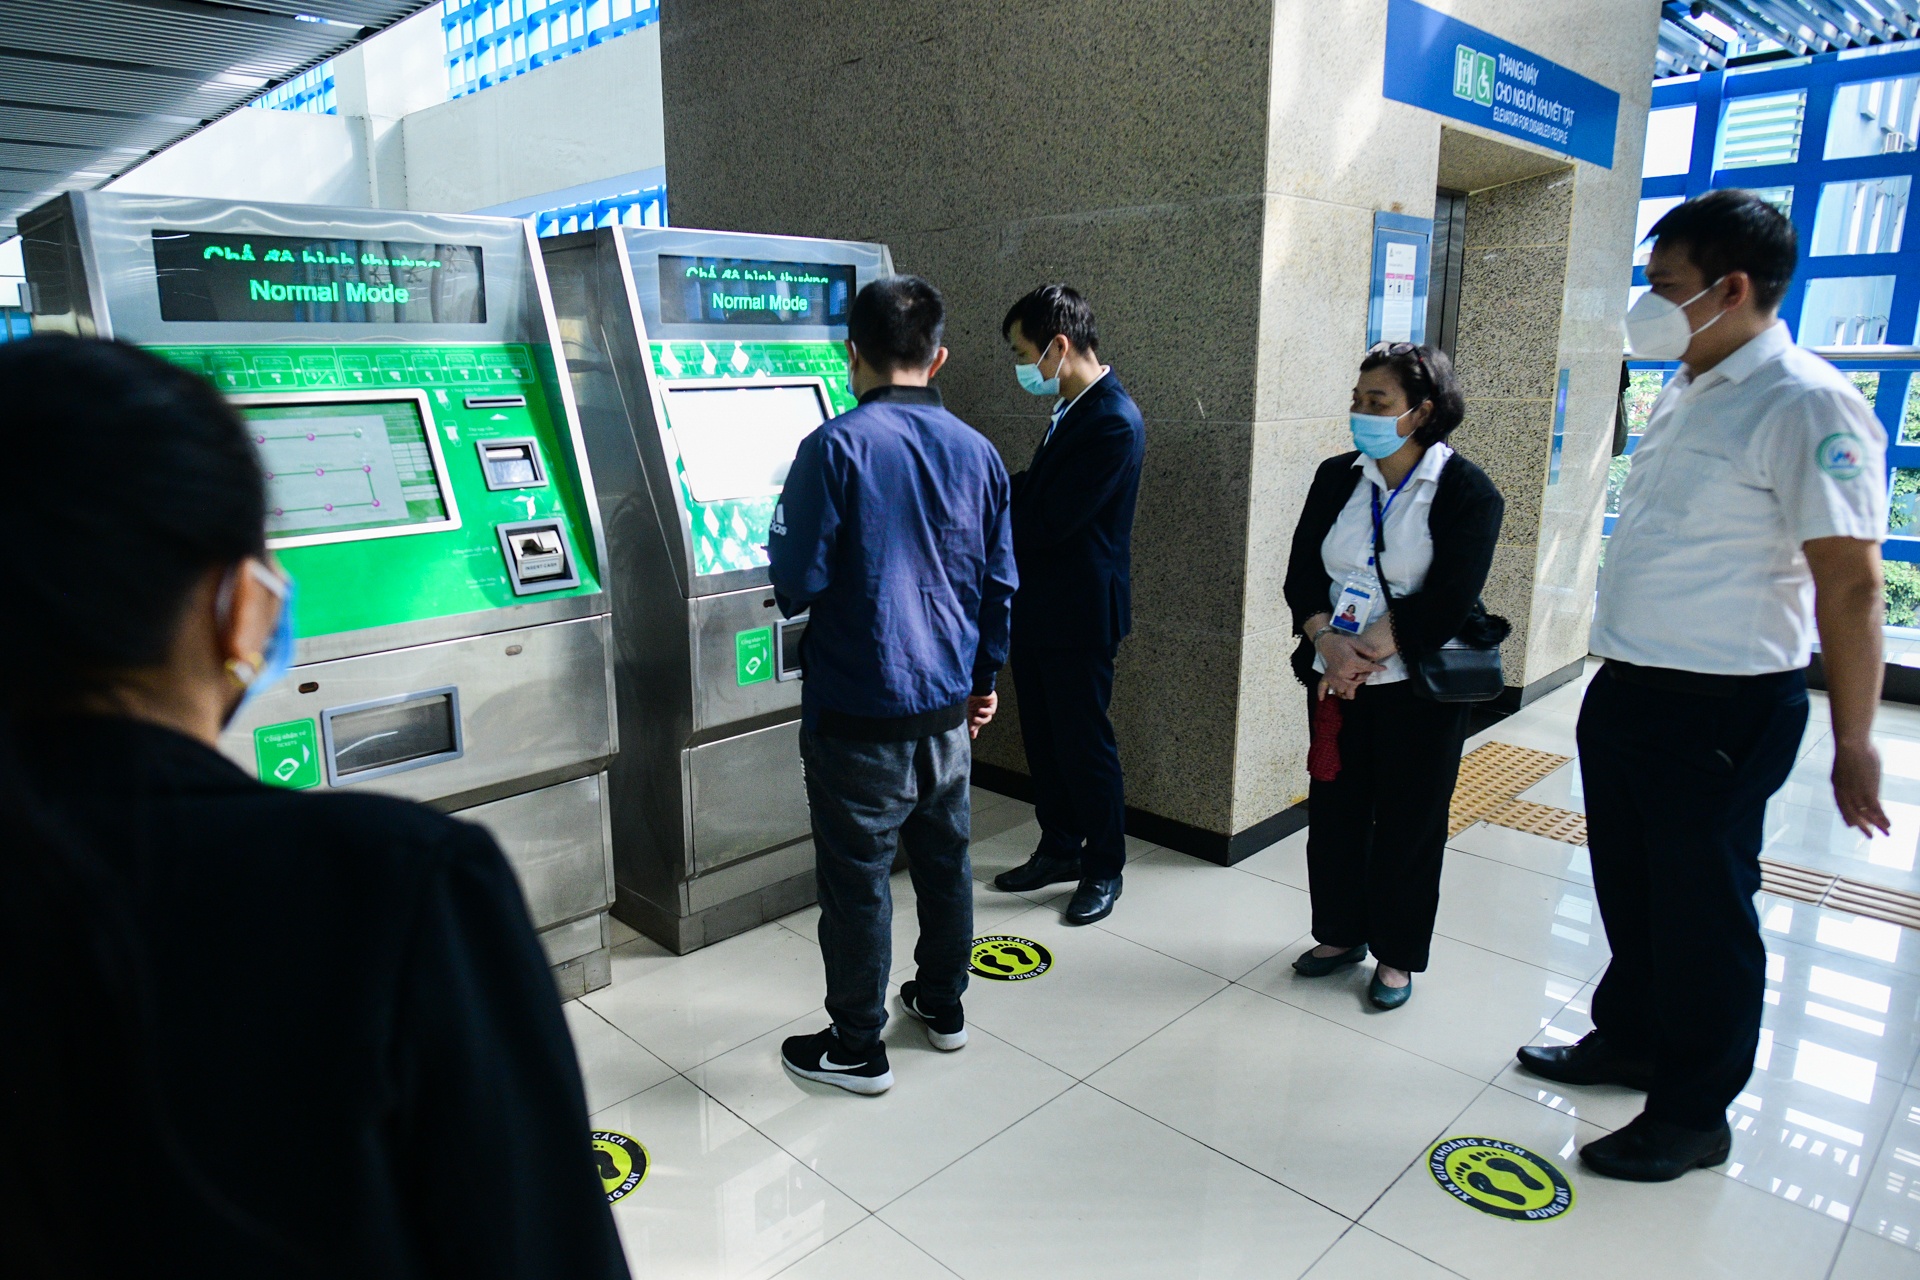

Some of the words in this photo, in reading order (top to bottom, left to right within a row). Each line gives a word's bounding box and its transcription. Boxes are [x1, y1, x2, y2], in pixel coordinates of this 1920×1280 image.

[1498, 53, 1524, 81] THANG
[1522, 62, 1540, 86] MÁY
[1495, 81, 1513, 104] CHO
[1493, 106, 1519, 128] ELEVATOR
[1518, 114, 1530, 131] FOR
[1528, 118, 1552, 139] DISABLED
[1550, 126, 1569, 145] PEOPLE
[249, 279, 339, 302] Normal
[345, 281, 410, 304] Mode
[712, 293, 765, 310] Normal
[769, 294, 808, 311] Mode
[592, 1132, 628, 1146] CÁCH
[1445, 1183, 1472, 1201] XIN
